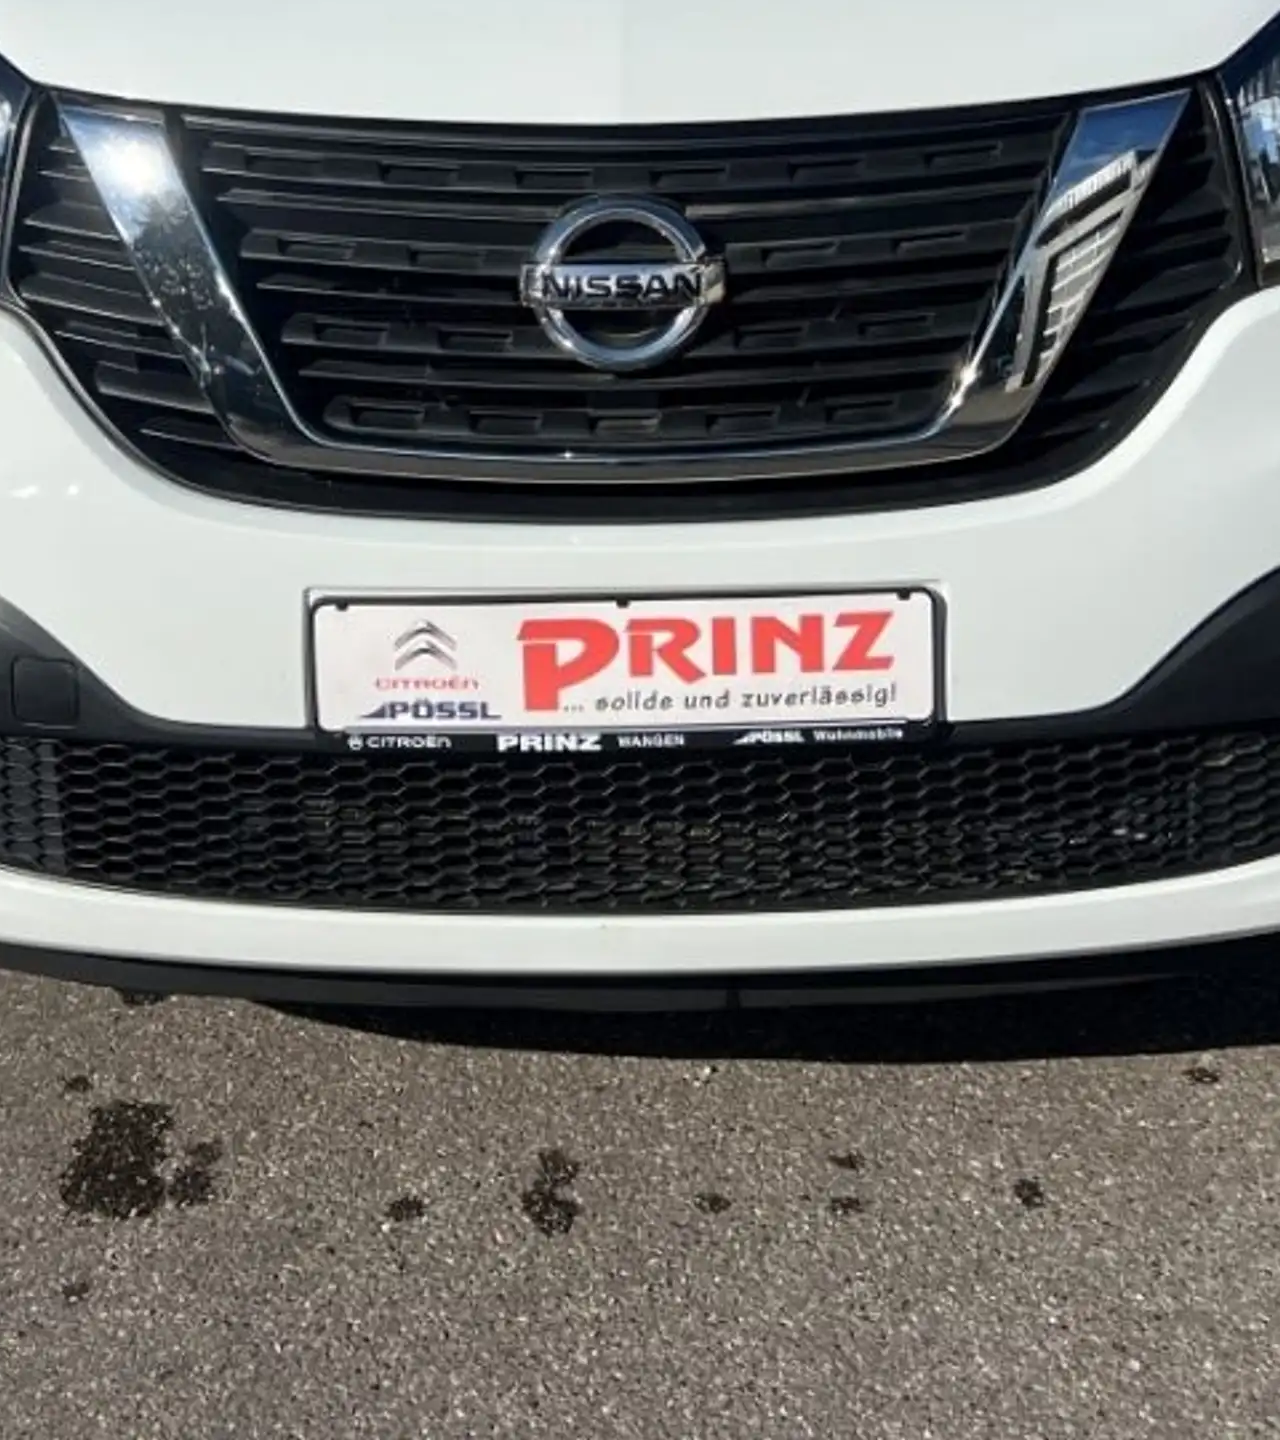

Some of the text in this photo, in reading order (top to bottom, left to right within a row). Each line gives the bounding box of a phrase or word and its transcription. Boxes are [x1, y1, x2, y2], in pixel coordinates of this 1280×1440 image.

[542, 273, 702, 300] NISSAN
[516, 611, 895, 712] PRINZ
[594, 688, 674, 711] solide
[683, 689, 731, 710] und
[740, 681, 898, 709] zuverlässig!
[496, 733, 603, 752] PRINZ
